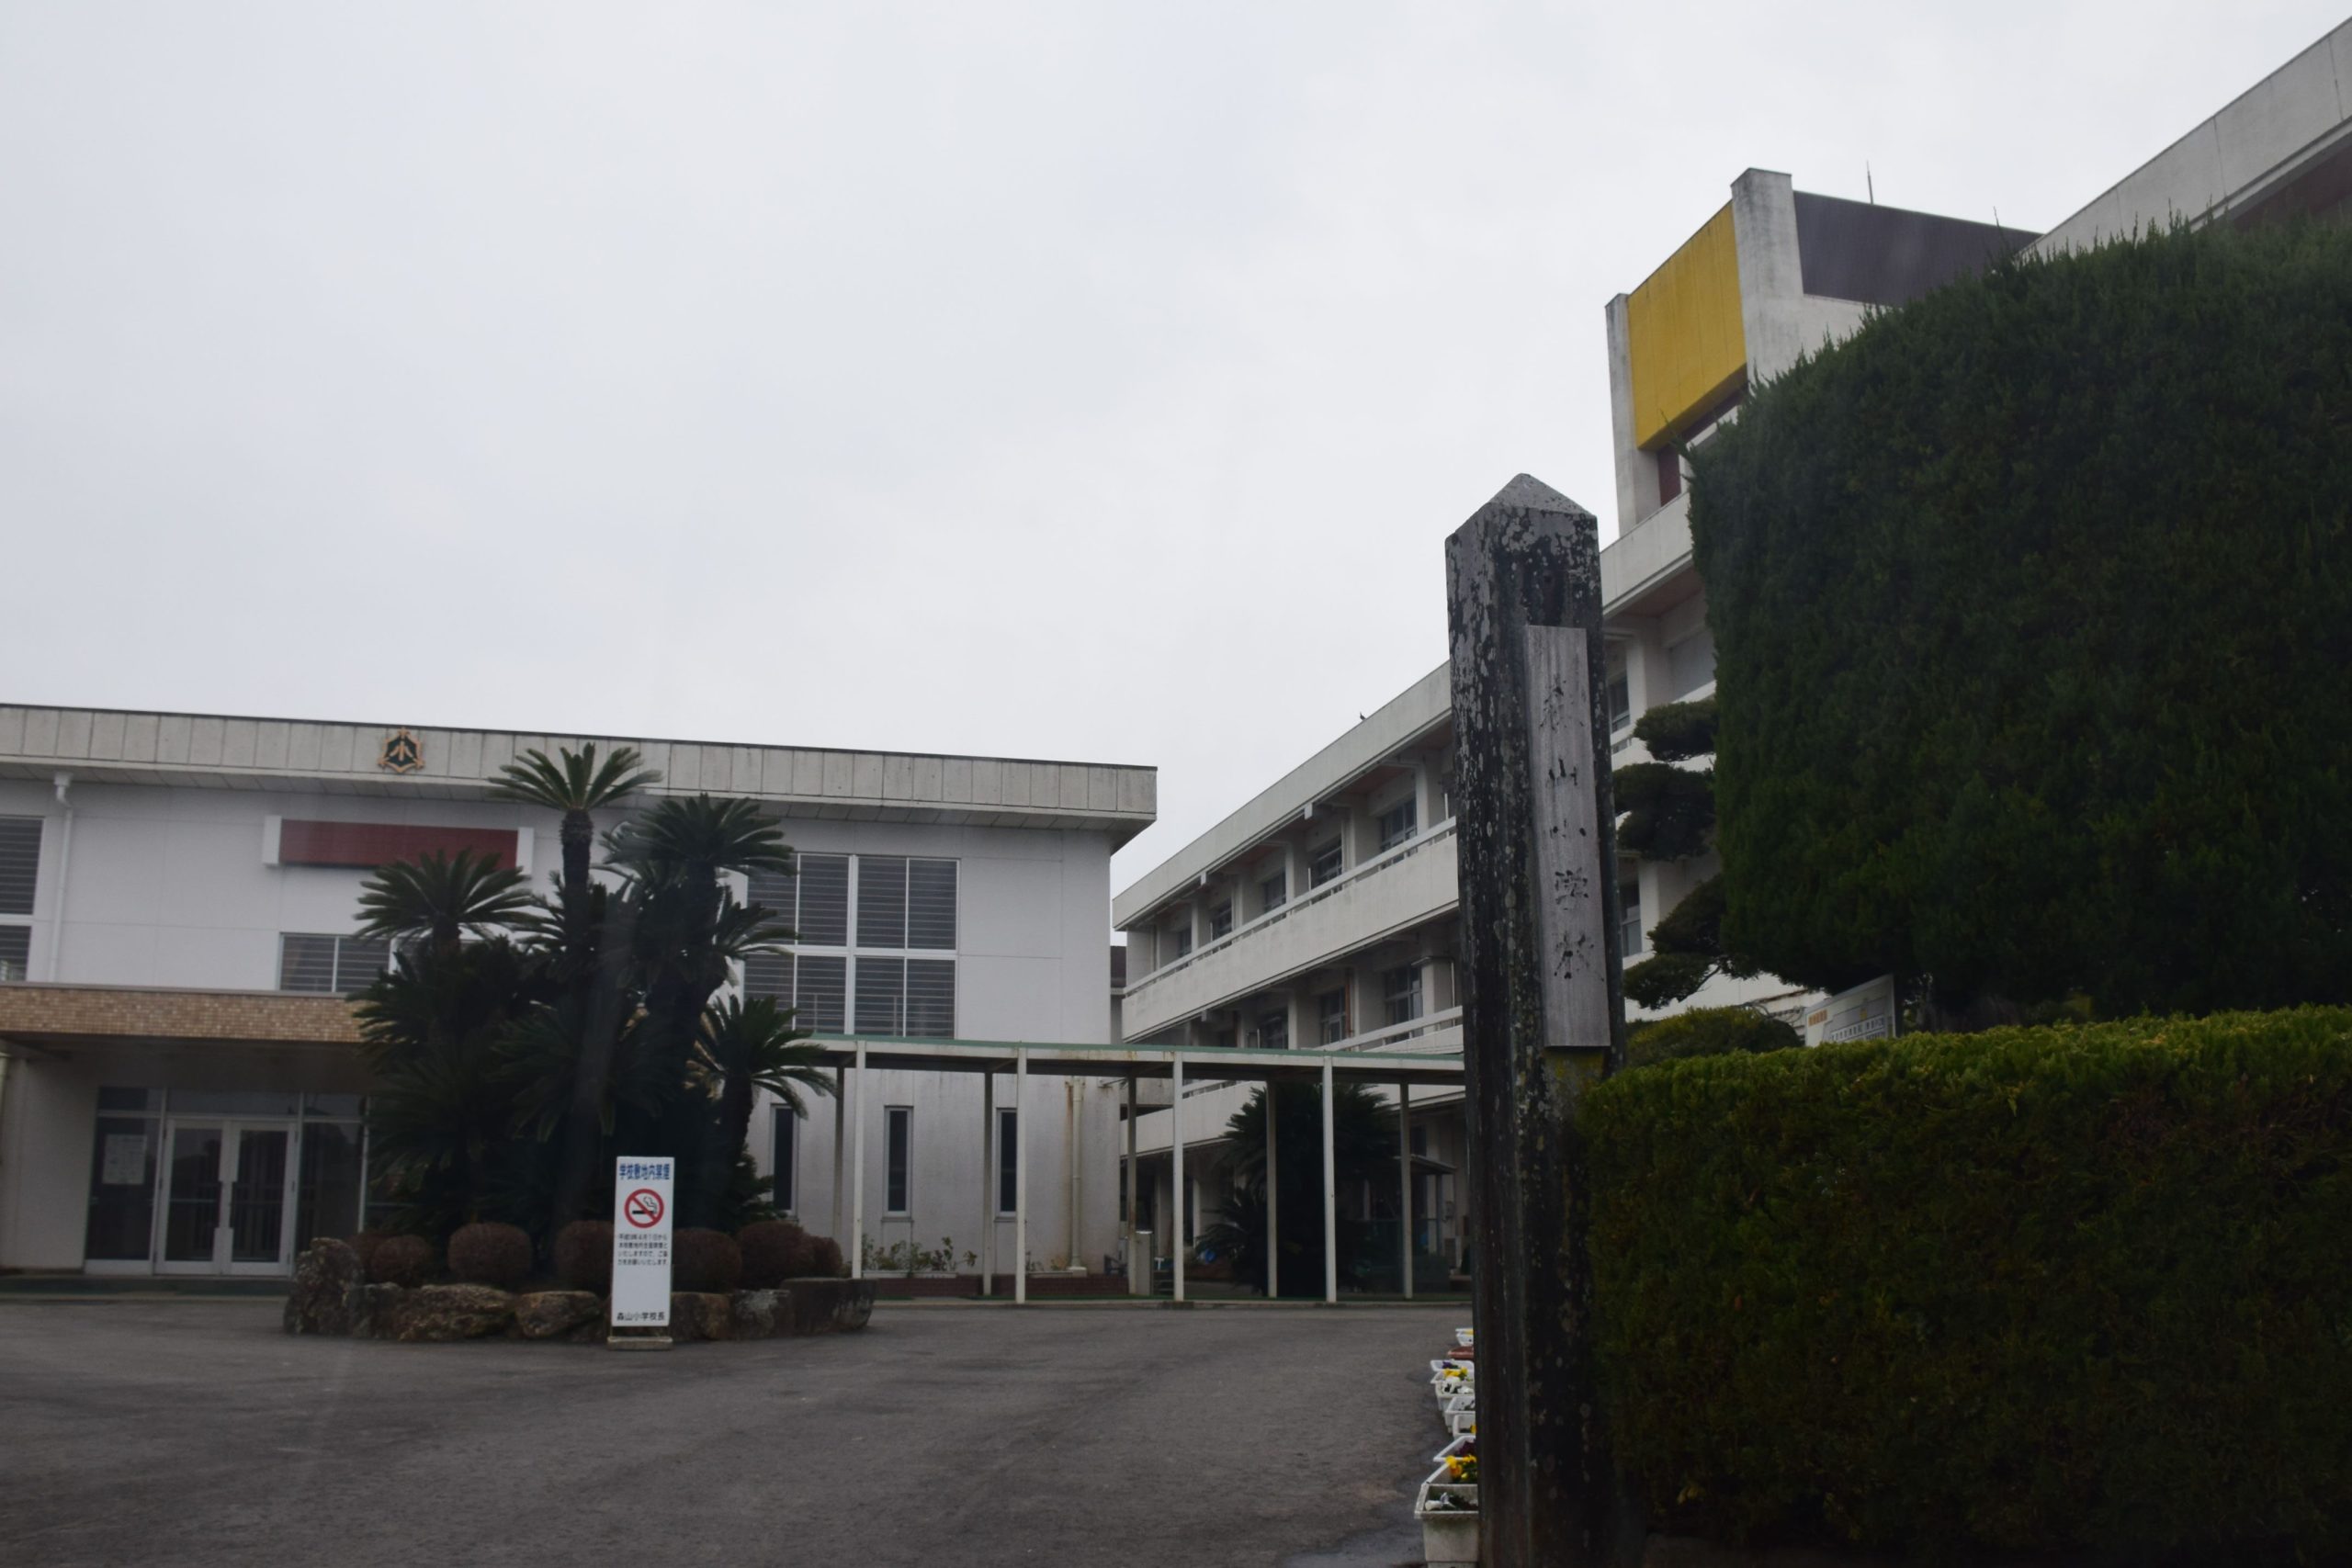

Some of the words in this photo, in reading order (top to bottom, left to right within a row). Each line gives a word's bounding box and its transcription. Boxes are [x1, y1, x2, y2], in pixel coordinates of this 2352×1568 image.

[619, 1163, 670, 1180] 学校敷地内禁煙
[616, 1311, 664, 1322] 森山小学校長
